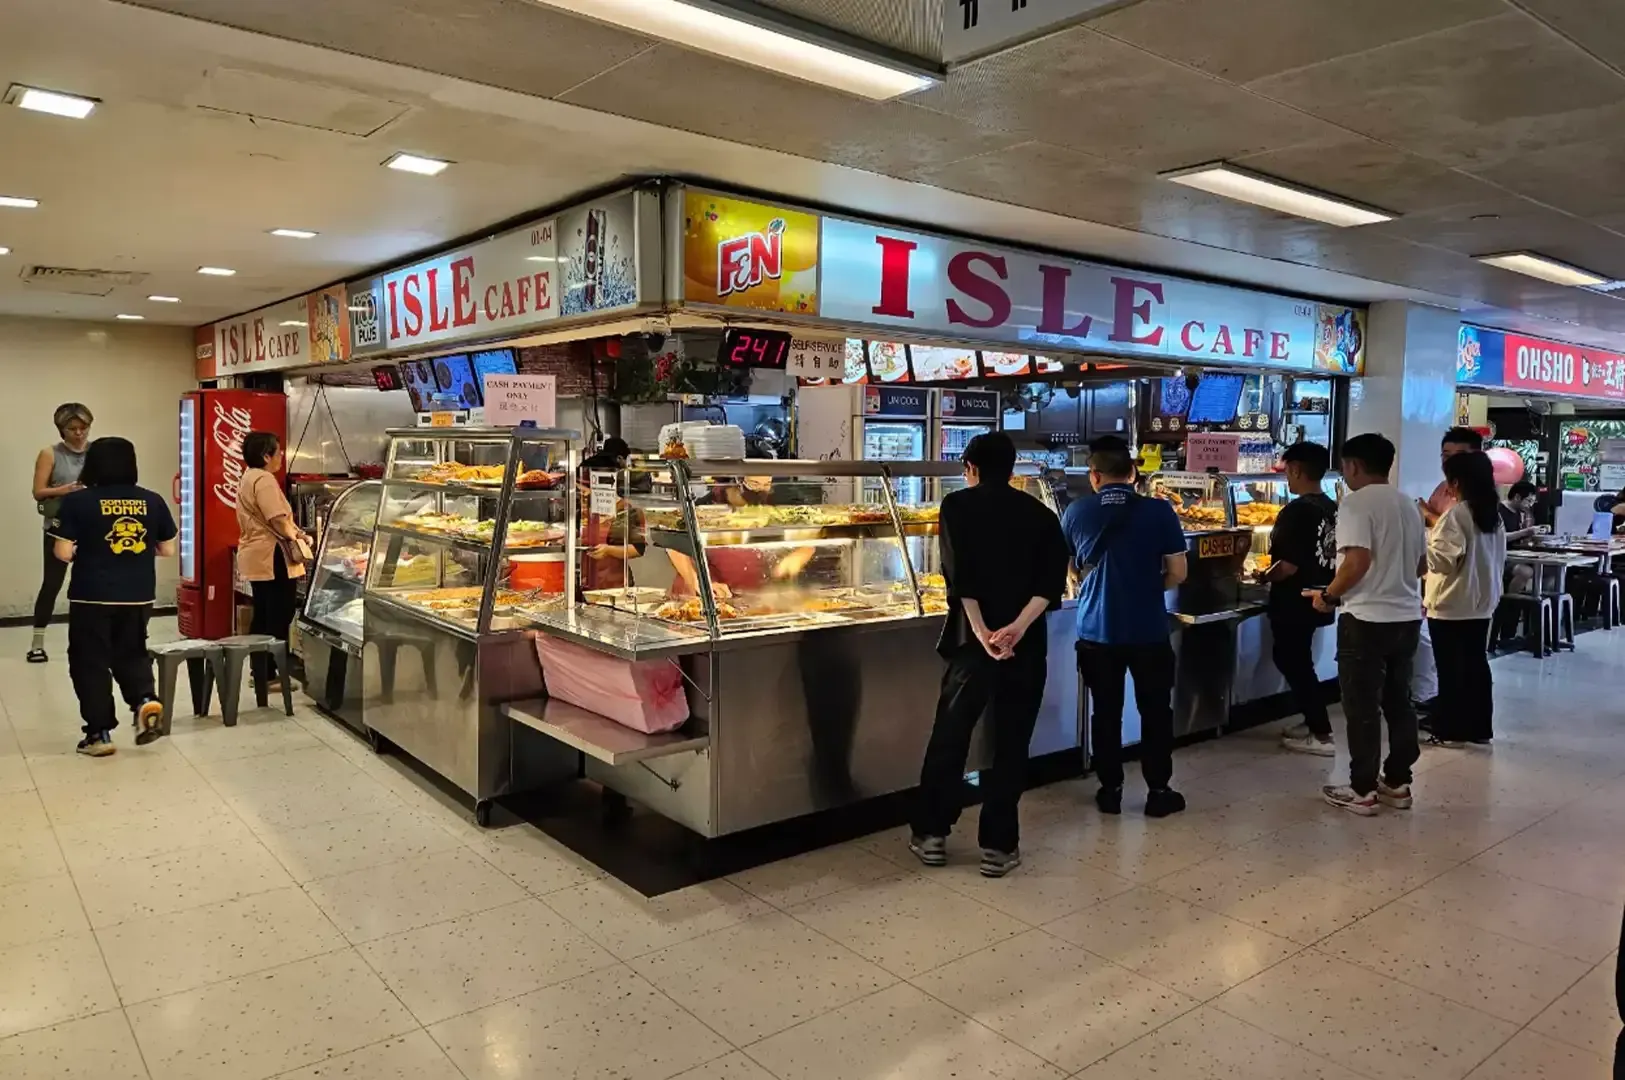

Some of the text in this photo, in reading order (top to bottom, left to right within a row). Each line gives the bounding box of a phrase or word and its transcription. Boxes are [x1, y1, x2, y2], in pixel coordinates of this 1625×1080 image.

[531, 225, 552, 247] 01-04
[719, 233, 782, 294] F&N
[387, 255, 551, 341] ISLE CAFE
[871, 234, 1290, 361] ISLE CAFE
[220, 316, 300, 367] ISLE CAFE
[358, 327, 377, 343] PLUS
[731, 335, 786, 365] 241
[792, 338, 843, 354] SELF-SERVICE
[1516, 344, 1575, 386] OHSHO
[486, 381, 552, 391] CASH PAYMENT
[506, 392, 529, 400] ONLY
